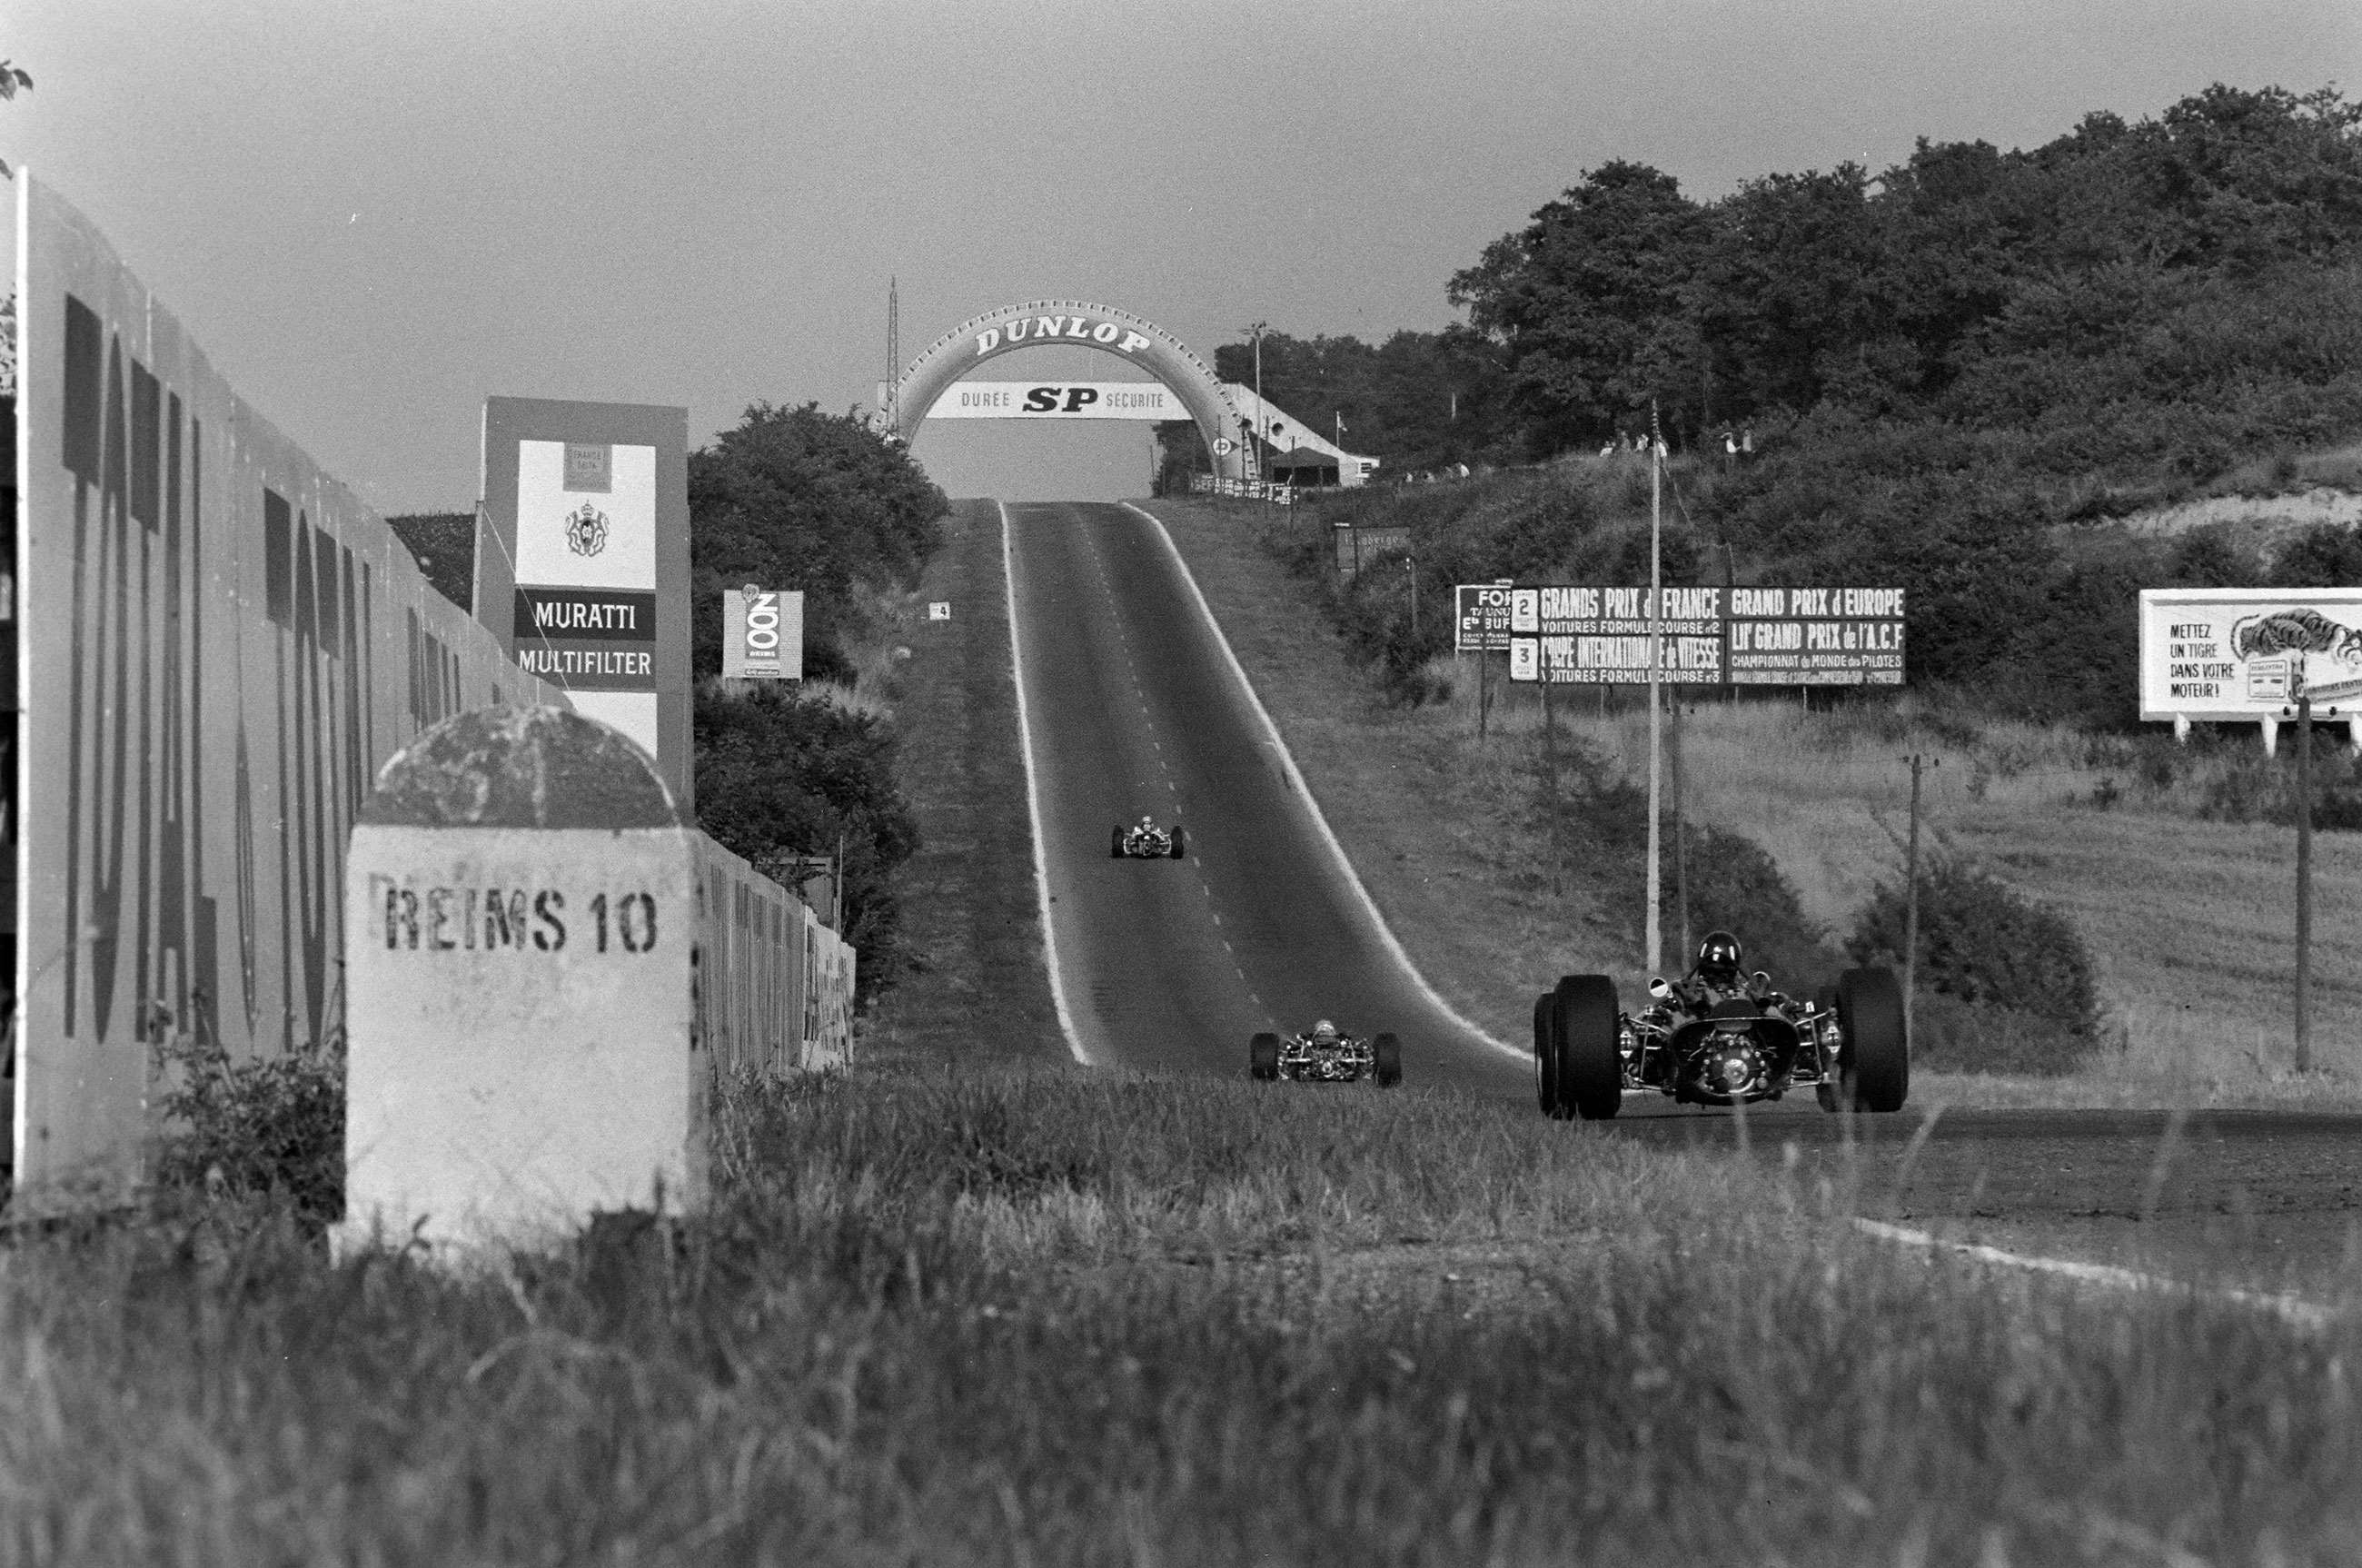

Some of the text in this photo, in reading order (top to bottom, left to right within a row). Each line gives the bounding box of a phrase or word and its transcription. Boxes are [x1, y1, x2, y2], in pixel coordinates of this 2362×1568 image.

[975, 316, 1150, 355] DUNLOP
[1022, 387, 1098, 412] SP
[1518, 599, 1530, 616] 2
[1540, 588, 1599, 619] GRANDS
[1604, 588, 1639, 619] PRIX
[1662, 588, 1720, 619] FRANCE
[1732, 589, 1784, 616] GRAND
[1791, 589, 1828, 616] PRIX
[534, 601, 636, 630] MURATTI
[1542, 621, 1597, 633] VOITURES
[1658, 621, 1704, 633] COURSE
[1754, 623, 1801, 650] GRAND
[1808, 623, 1841, 650] PRIX
[1843, 623, 1856, 650] de
[2169, 623, 2211, 639] METTEZ
[519, 650, 651, 676] MULTIFILTER
[1518, 647, 1530, 663] 3
[1678, 638, 1720, 669] VITESSE
[1732, 654, 1799, 668] CHAMPIONNAT
[1811, 654, 1847, 668] MONDE
[1862, 654, 1902, 668] PILOTES
[2170, 642, 2218, 659] UN TIGRE
[1658, 670, 1704, 682] COURSE
[2170, 663, 2199, 678] DANS
[2202, 662, 2235, 679] VOTRE
[386, 888, 657, 953] REIMS 10
